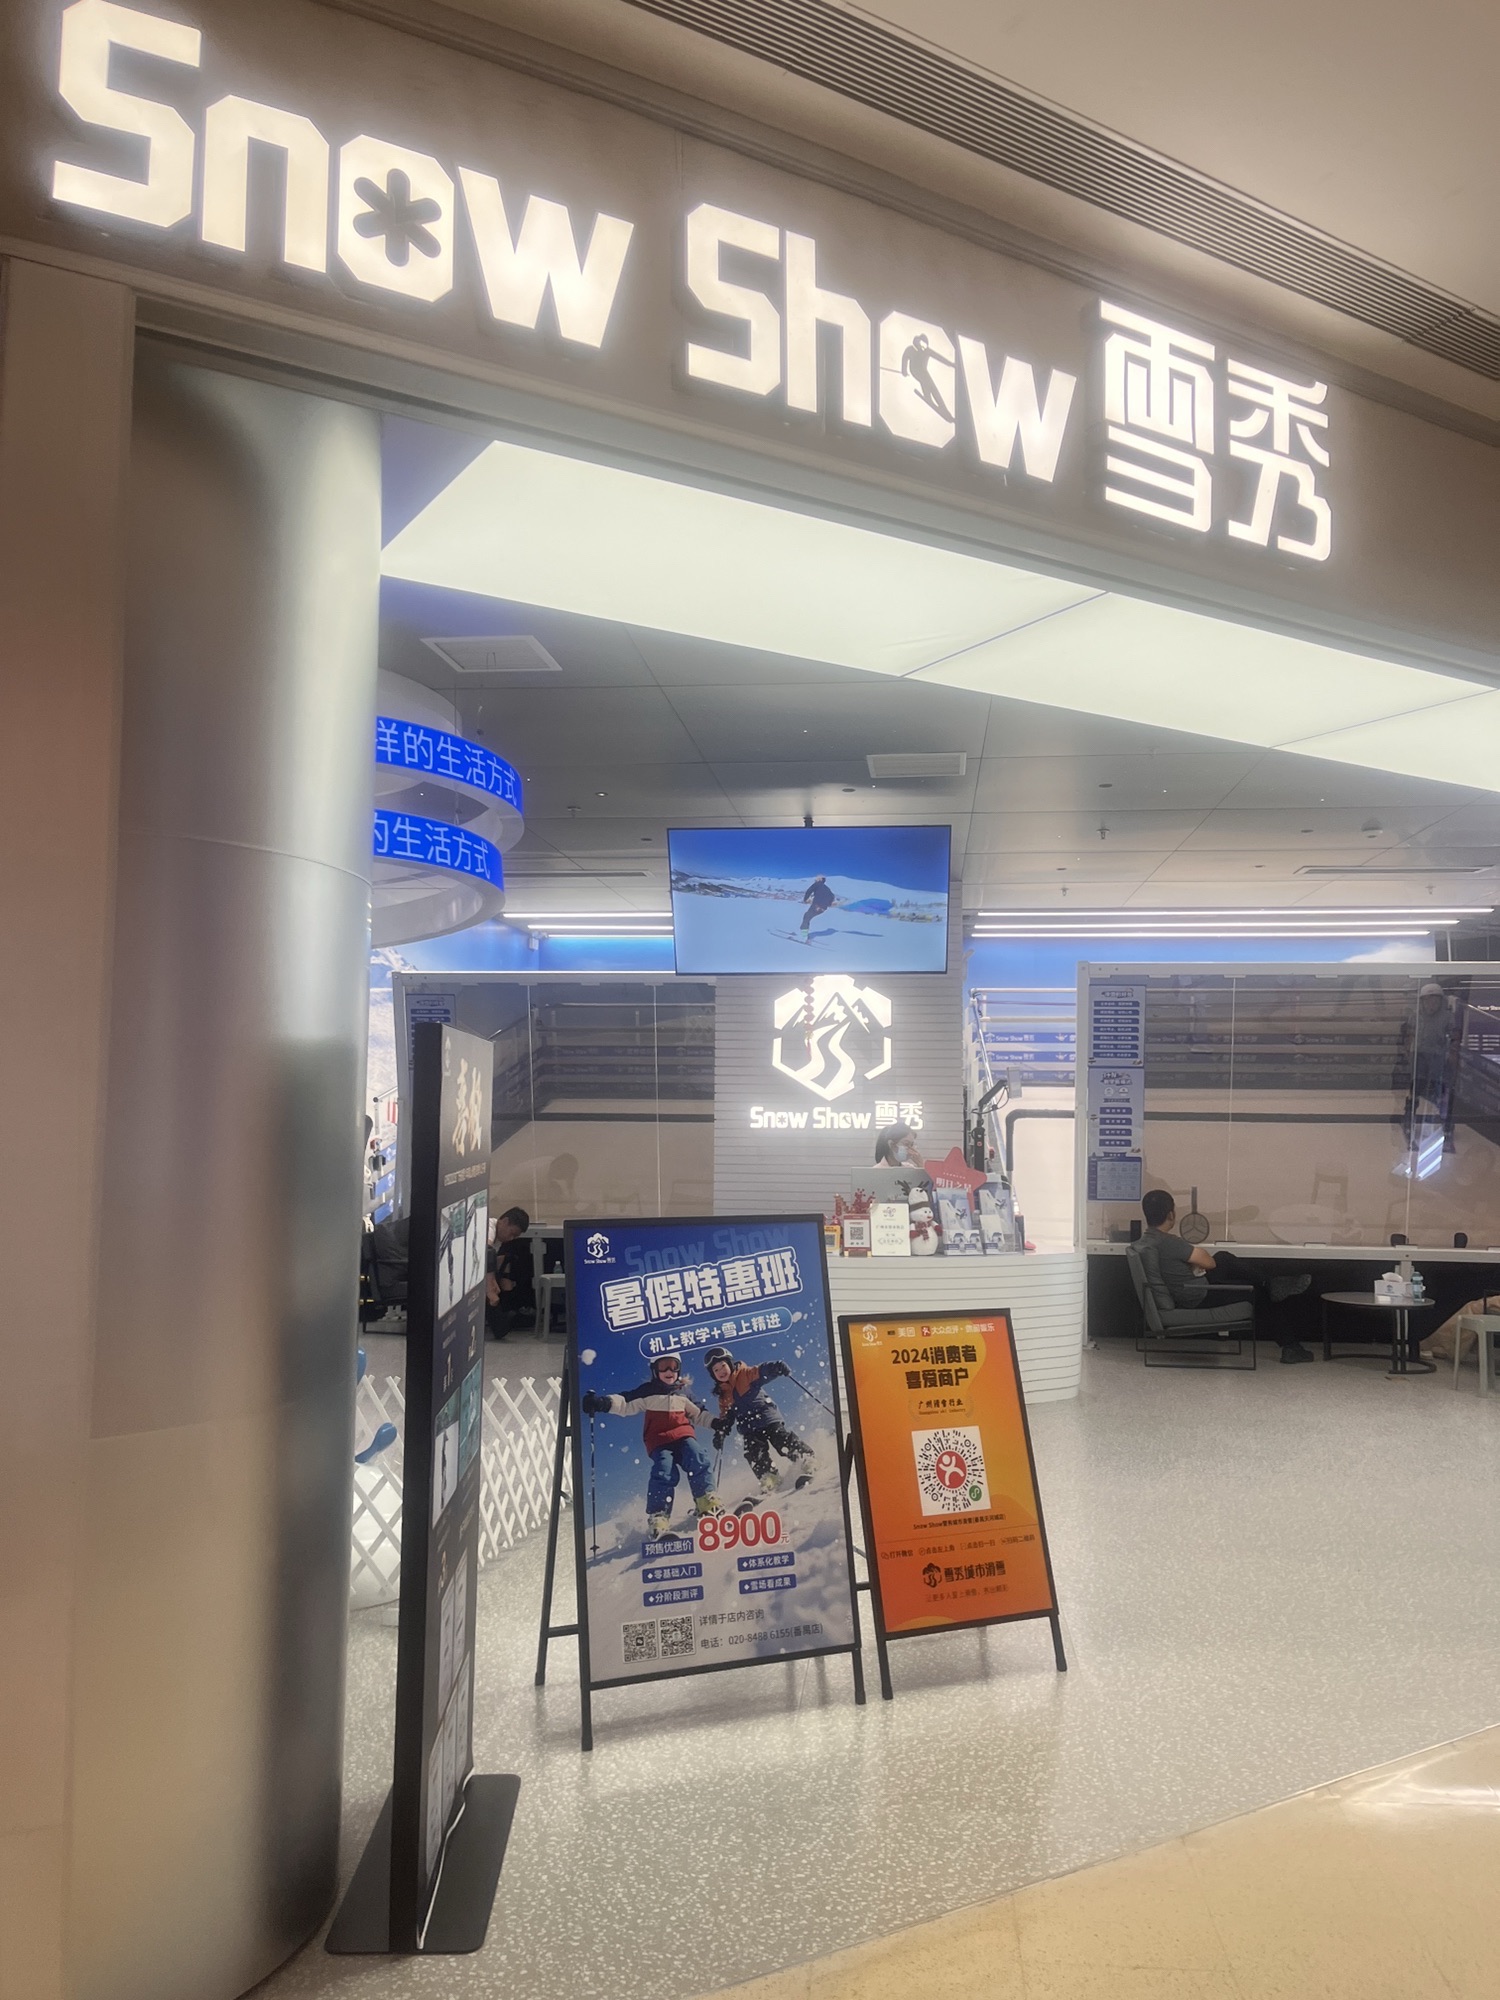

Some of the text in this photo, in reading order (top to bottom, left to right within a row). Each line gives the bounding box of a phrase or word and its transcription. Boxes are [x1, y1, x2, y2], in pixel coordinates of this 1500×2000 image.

[53, 1, 1076, 482] Snow Show
[1100, 300, 1333, 562] 雪秀
[750, 1101, 923, 1130] Snow Show 雪秀
[625, 1227, 790, 1277] Snow Show
[605, 1251, 799, 1327] 暑假特惠班
[649, 1313, 781, 1353] 机上教学+雪上精进
[891, 1345, 977, 1364] 2024消费者
[905, 1367, 969, 1389] 喜爱商户
[645, 1540, 692, 1556] 预售优惠价
[748, 1554, 790, 1567] 体系化教学
[944, 1560, 1006, 1583] 雪秀城市滑雪
[654, 1566, 697, 1579] 零基础入门
[750, 1578, 791, 1591] 雪场看成果
[655, 1589, 699, 1603] 分阶段测评
[699, 1609, 765, 1626] 详情于店内咨询
